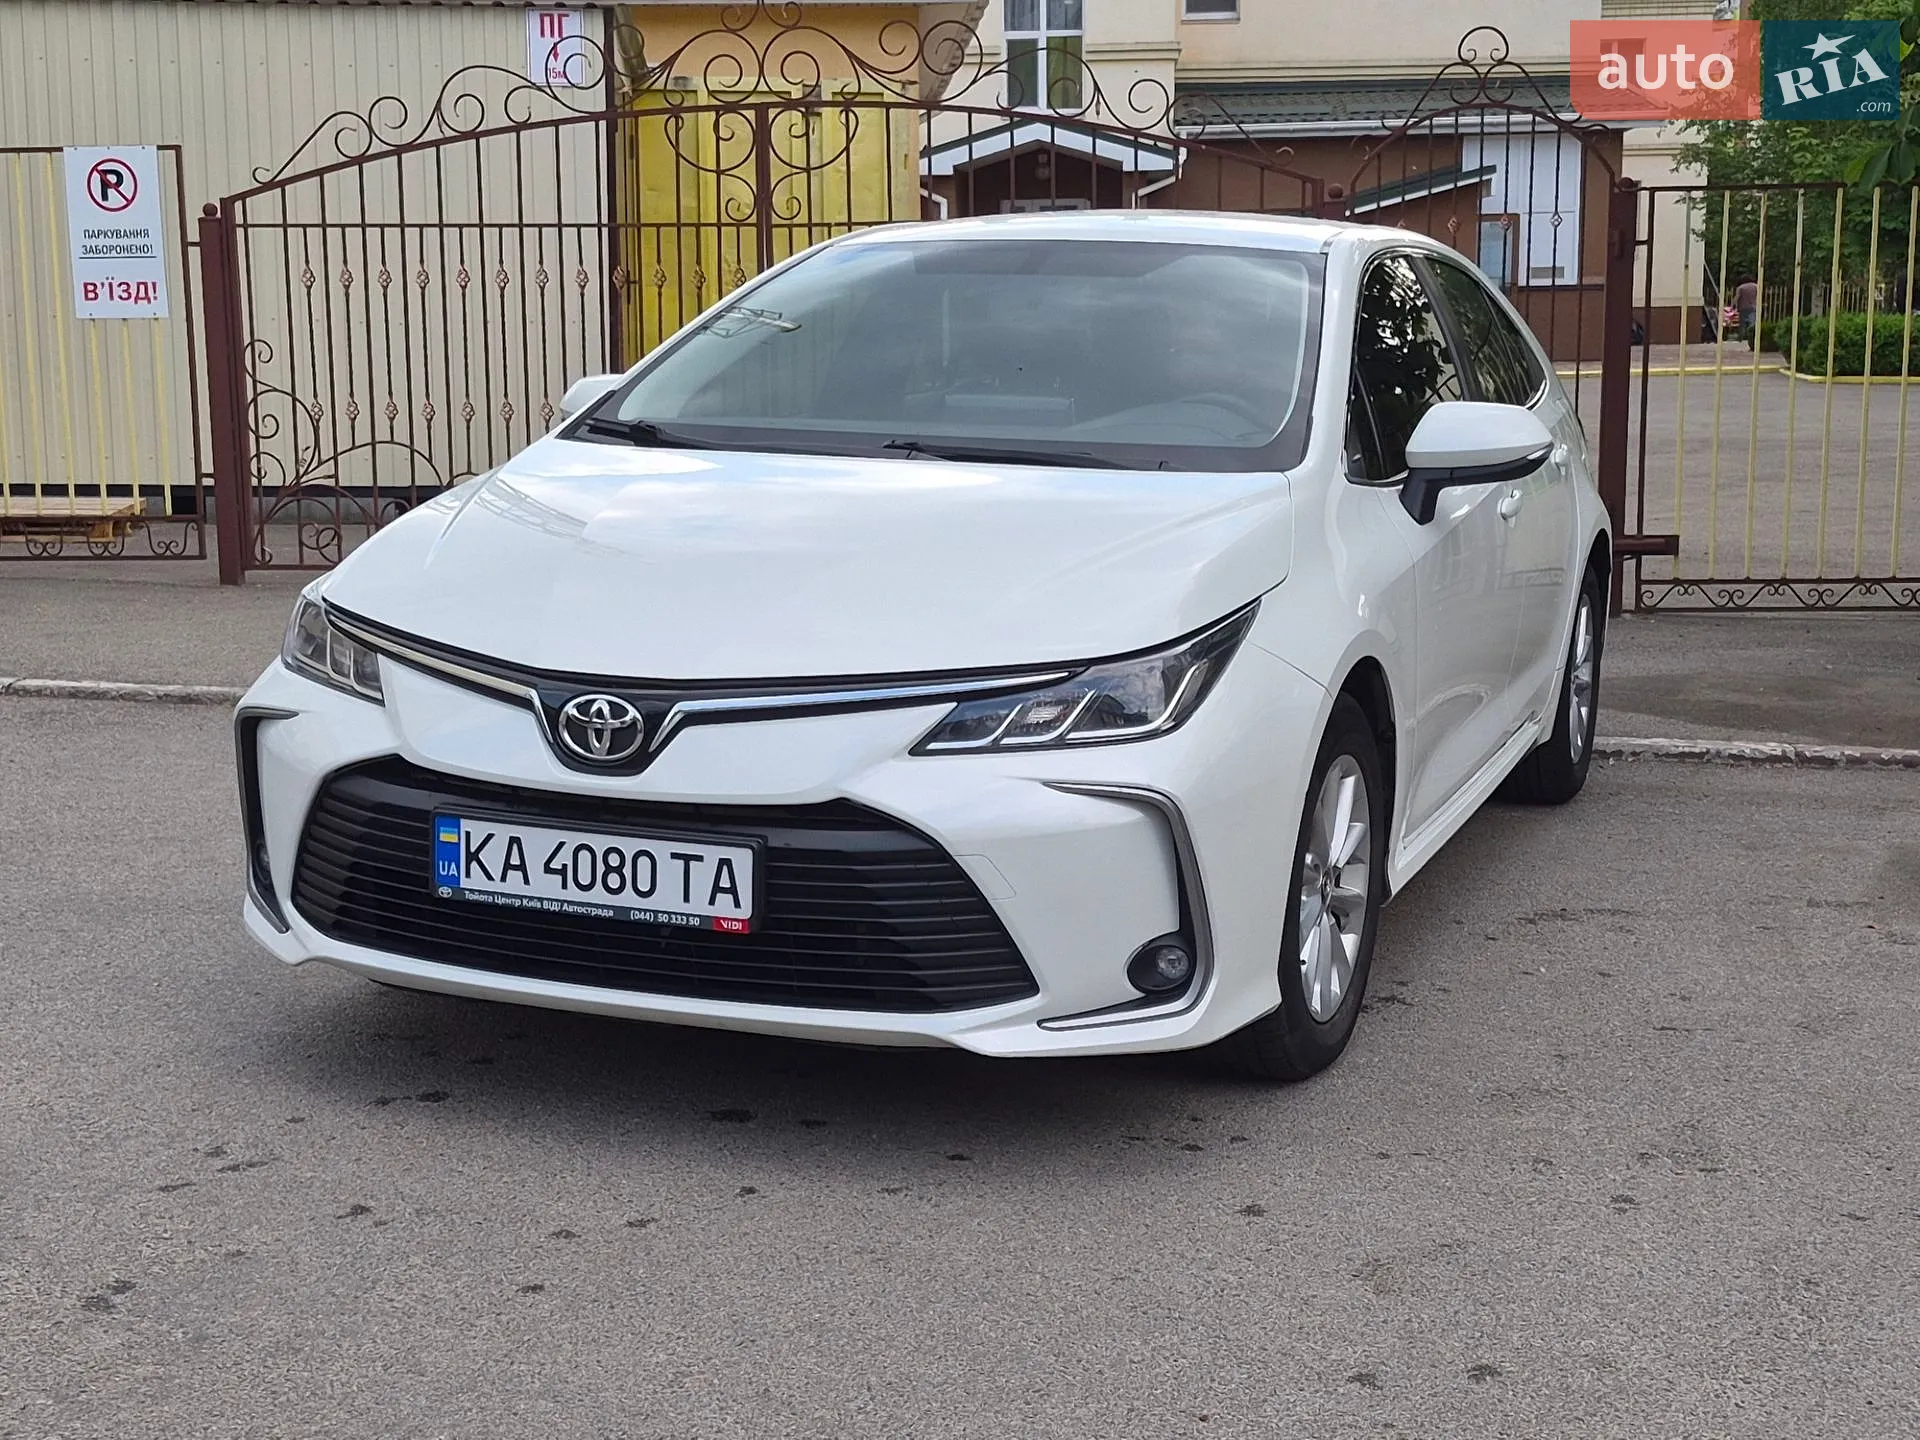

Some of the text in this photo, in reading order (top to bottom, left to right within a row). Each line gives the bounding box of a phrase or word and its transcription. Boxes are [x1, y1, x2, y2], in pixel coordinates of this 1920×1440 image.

[539, 12, 570, 39] ПГ
[83, 227, 150, 241] ПАРКУВАННЯ
[81, 244, 154, 256] ЗАБОРОНЕНО!
[439, 860, 459, 877] UA
[464, 830, 742, 909] KA 4080 TA
[464, 890, 493, 903] Тойота
[494, 895, 521, 907] Центр
[522, 899, 542, 909] Київ
[562, 903, 614, 917] Автострада
[630, 910, 700, 926] (044) 50 333 50
[720, 919, 742, 930] VIDI
